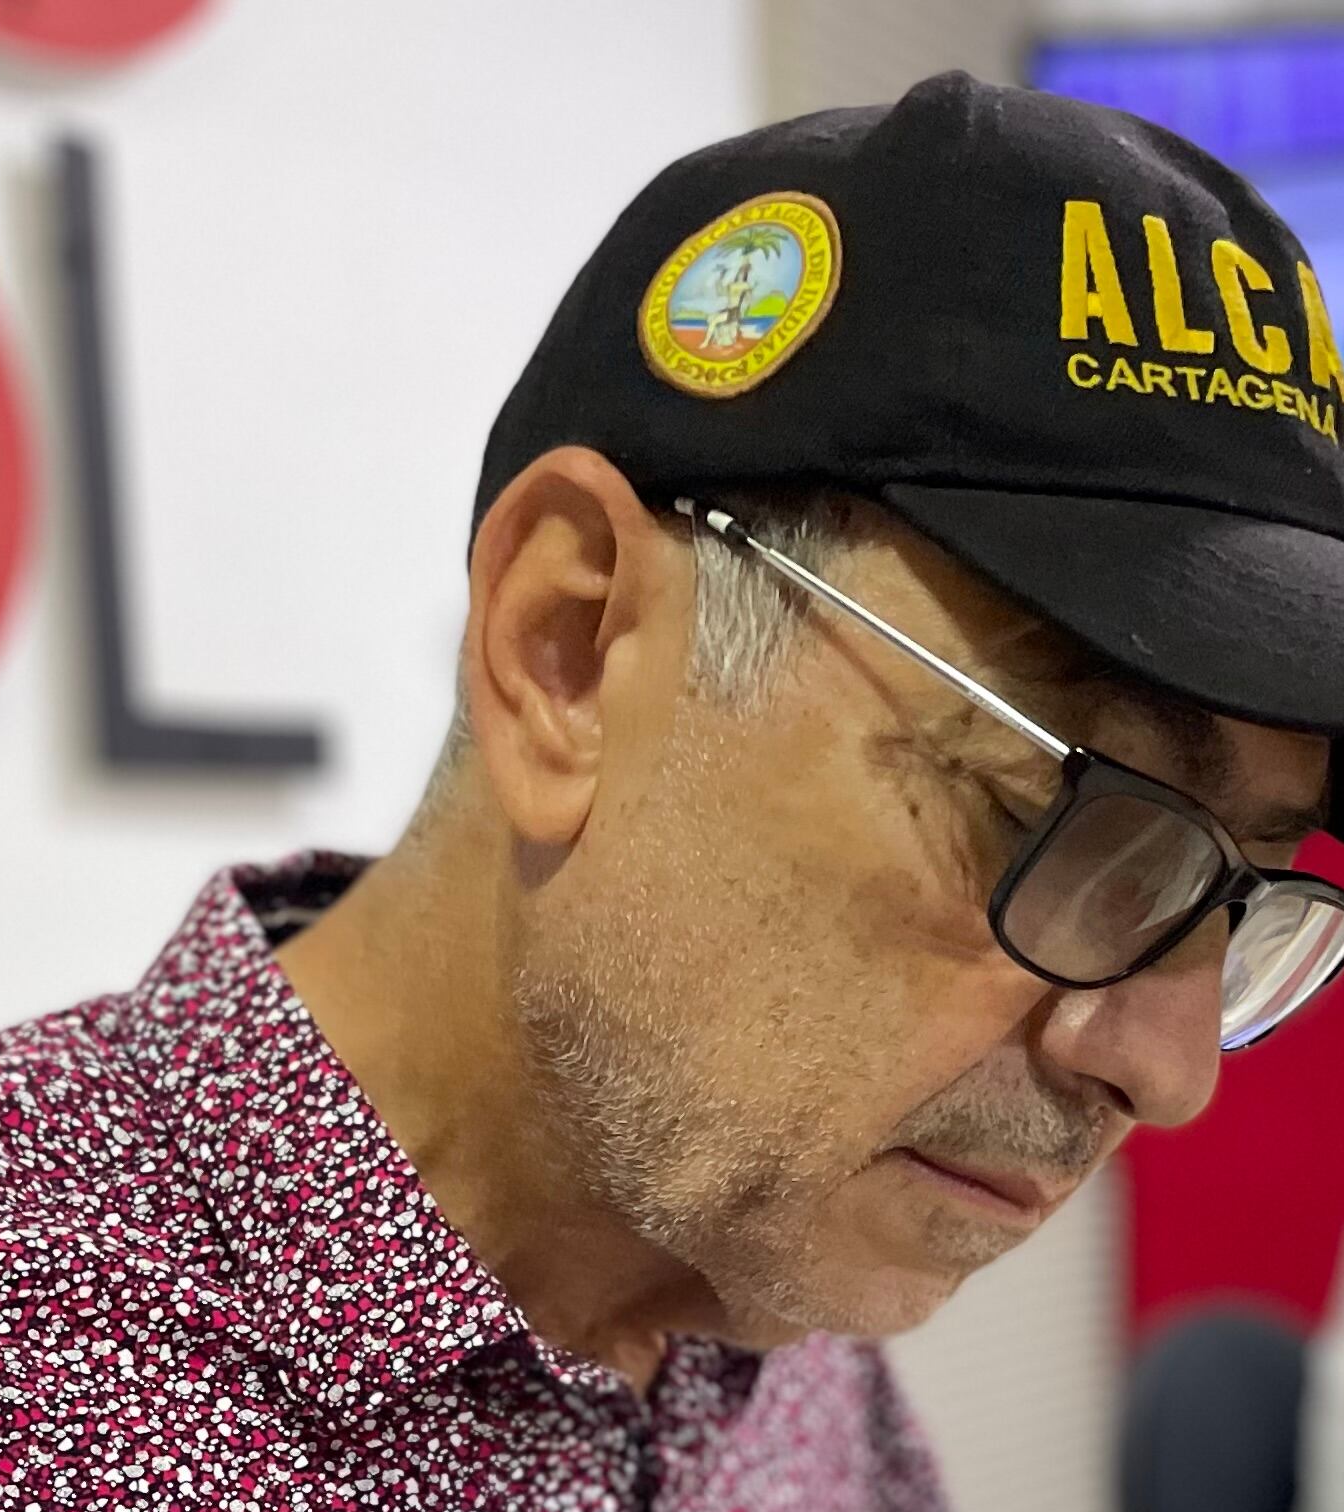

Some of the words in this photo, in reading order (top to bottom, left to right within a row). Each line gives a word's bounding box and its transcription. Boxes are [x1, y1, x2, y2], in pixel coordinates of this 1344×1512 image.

[807, 250, 825, 284] DE
[753, 288, 819, 364] INDIAS
[1067, 352, 1339, 447] CARTAGENA
